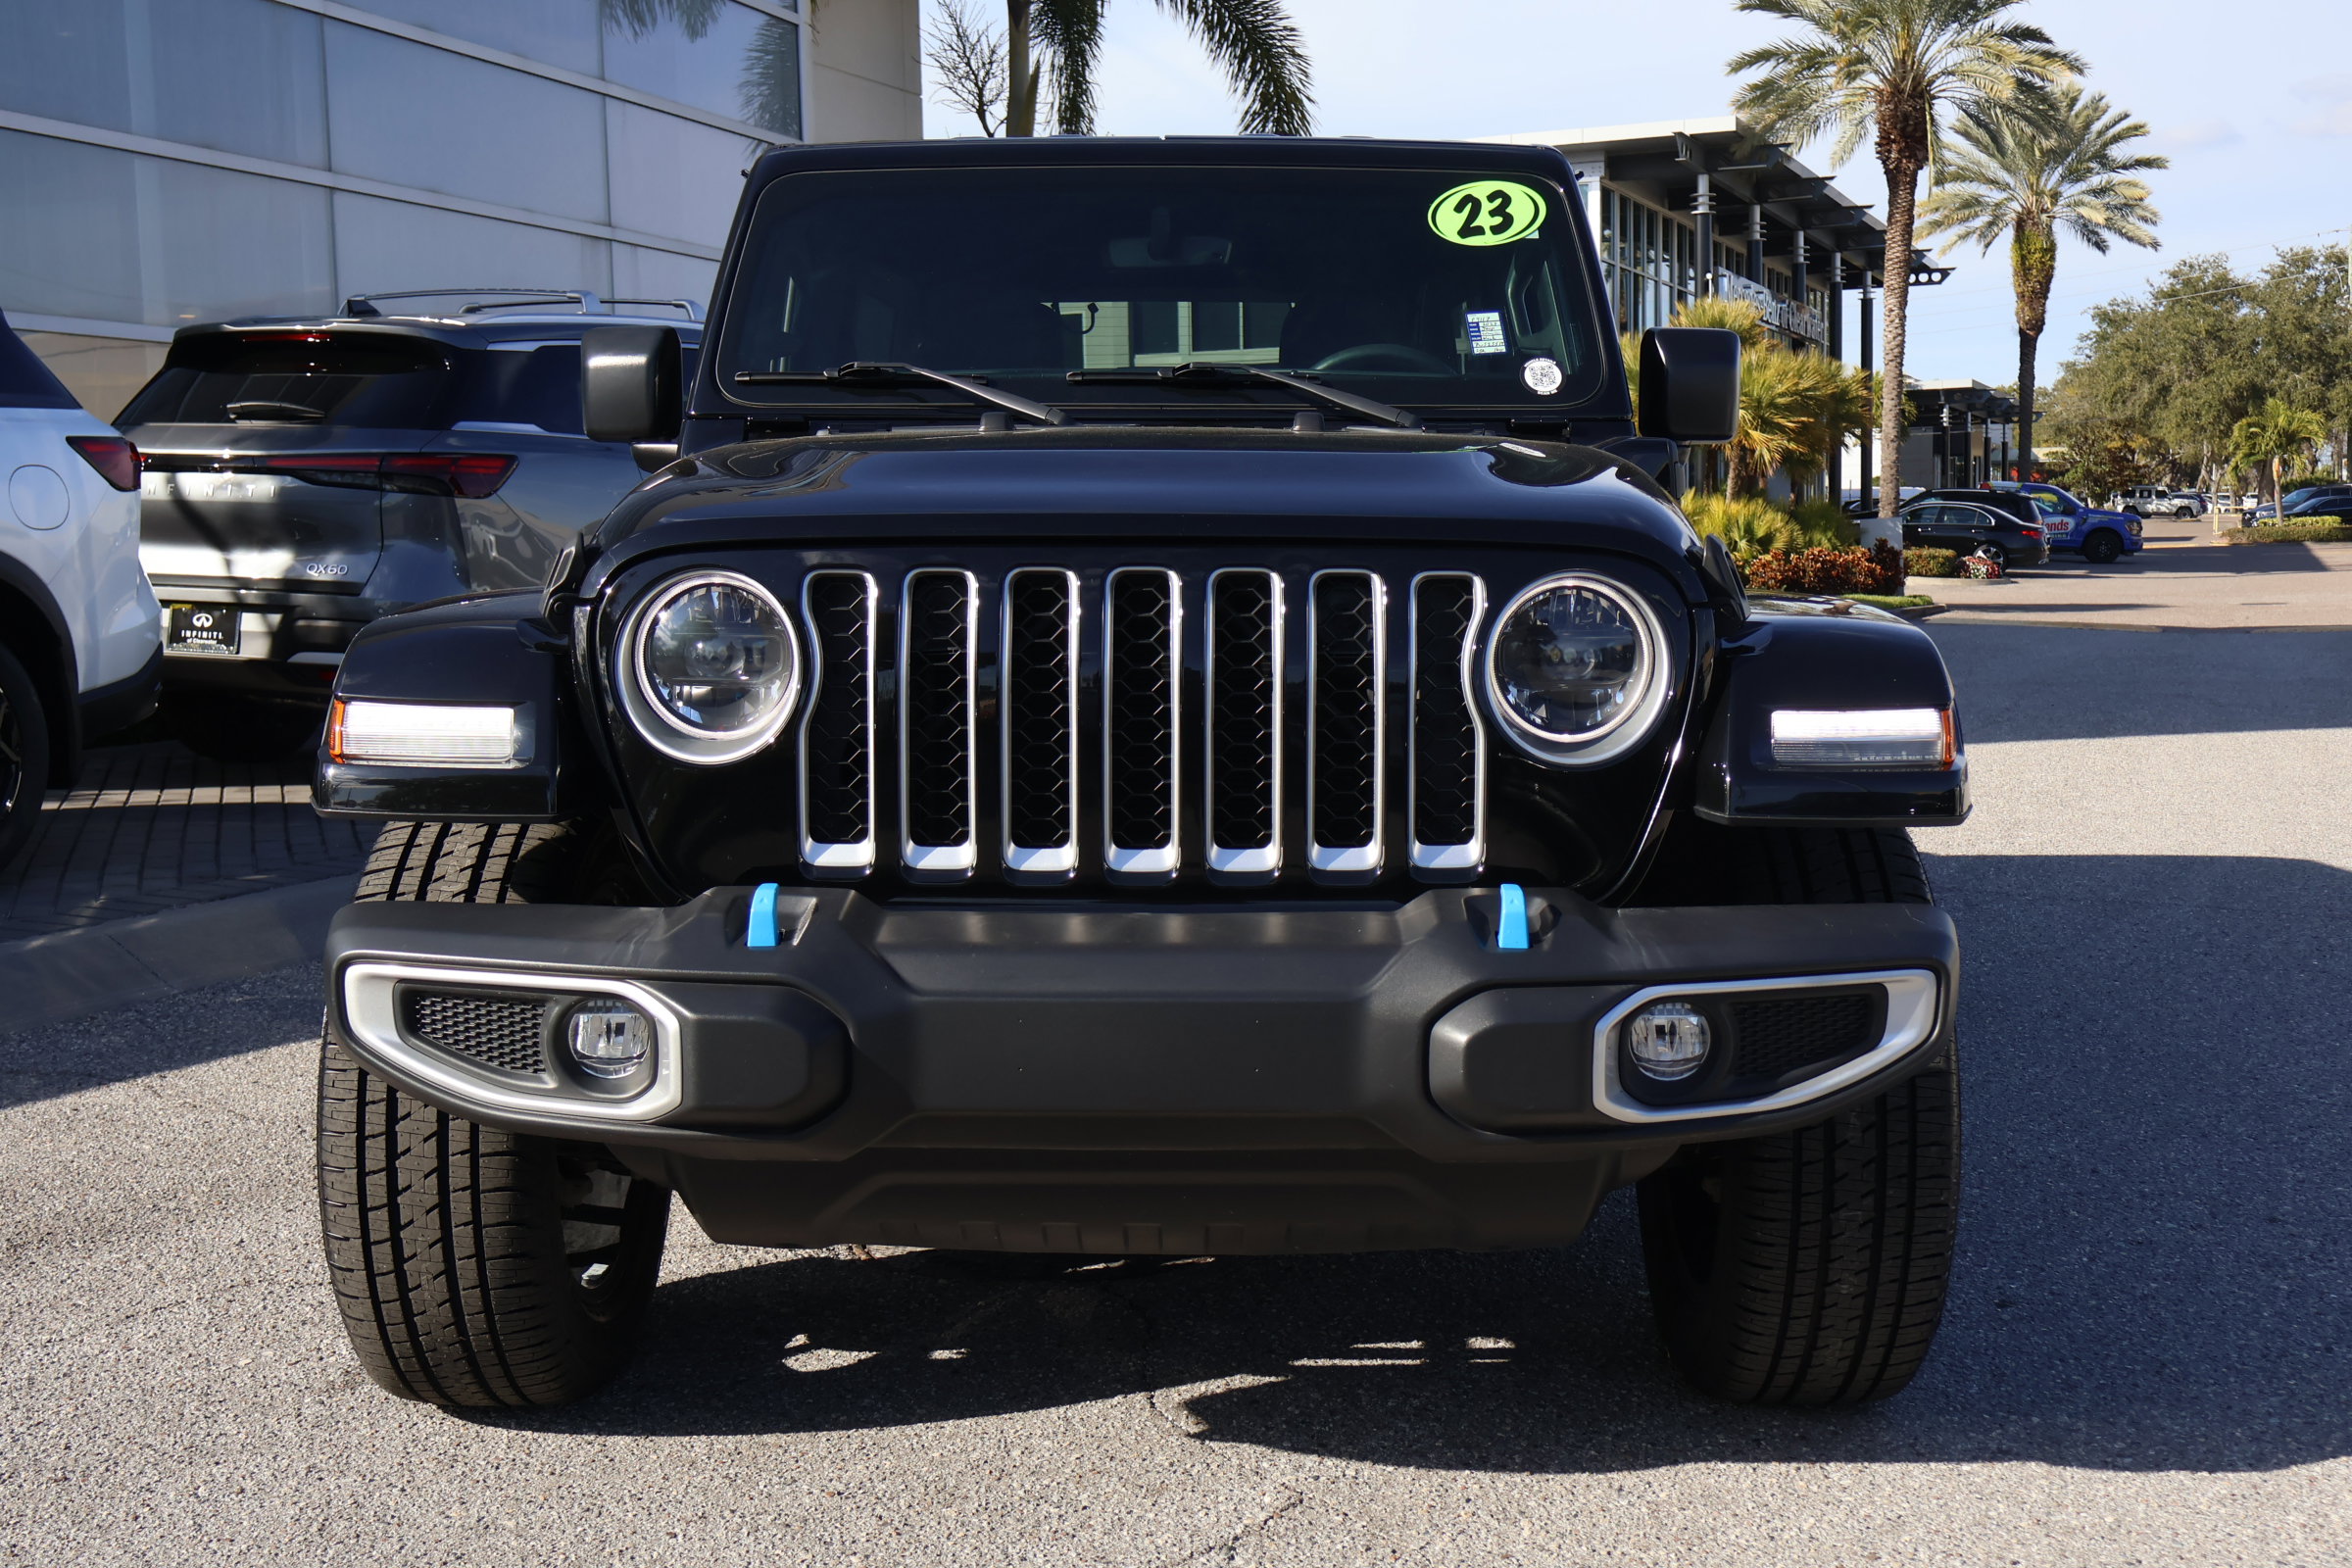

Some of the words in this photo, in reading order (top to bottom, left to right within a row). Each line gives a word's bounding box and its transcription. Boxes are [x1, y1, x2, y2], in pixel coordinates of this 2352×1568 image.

[1453, 189, 1514, 239] 23
[147, 483, 276, 498] NFINITI
[2044, 518, 2070, 532] ands
[306, 563, 349, 577] QX60
[181, 629, 222, 640] INFINITI
